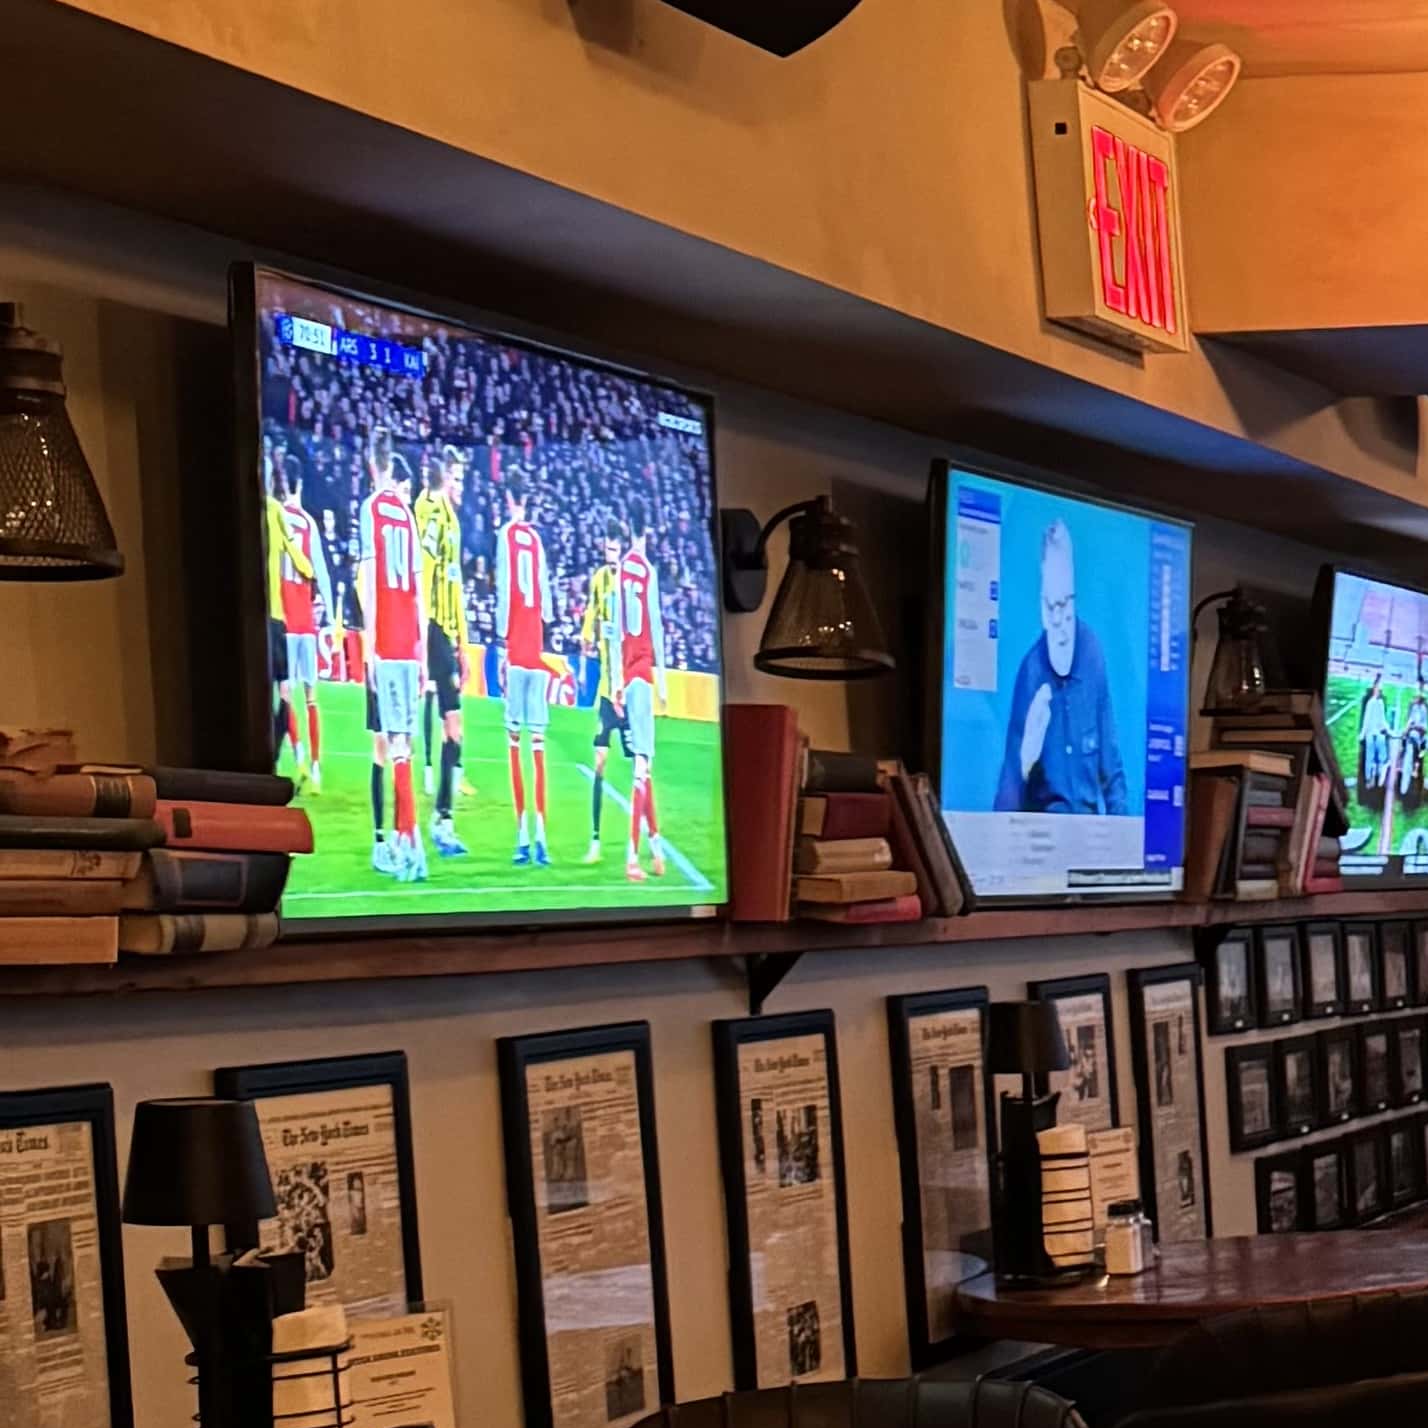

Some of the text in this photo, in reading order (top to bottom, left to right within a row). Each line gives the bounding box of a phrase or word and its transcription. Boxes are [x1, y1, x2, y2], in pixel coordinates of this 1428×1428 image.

[1091, 124, 1176, 334] EXIT
[16, 1131, 49, 1153] Times
[282, 1120, 369, 1147] The New York Times
